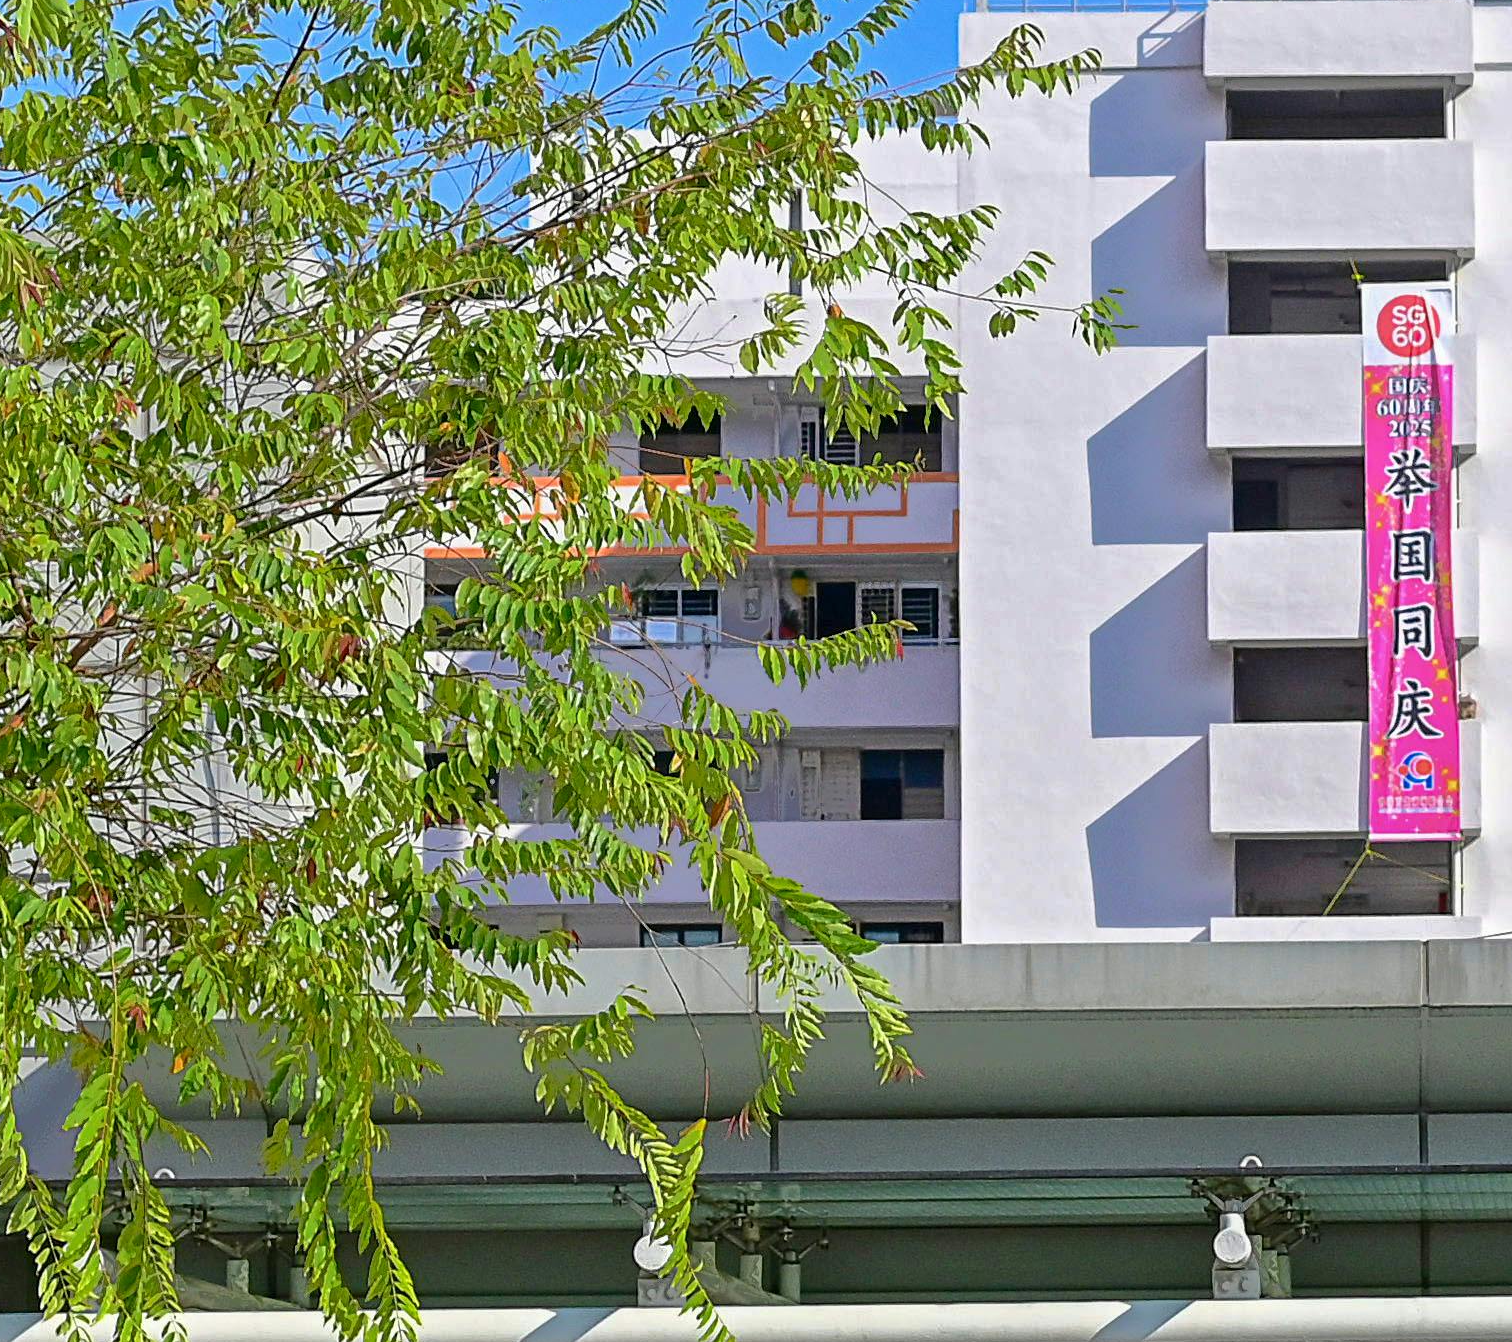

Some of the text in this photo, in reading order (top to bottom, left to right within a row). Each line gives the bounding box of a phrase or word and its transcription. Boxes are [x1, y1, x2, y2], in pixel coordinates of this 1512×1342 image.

[1392, 305, 1426, 325] SG
[1392, 326, 1426, 347] 60
[1388, 376, 1431, 395] 国庆
[1388, 419, 1432, 437] 2025
[1385, 448, 1443, 739] 举国同庆
